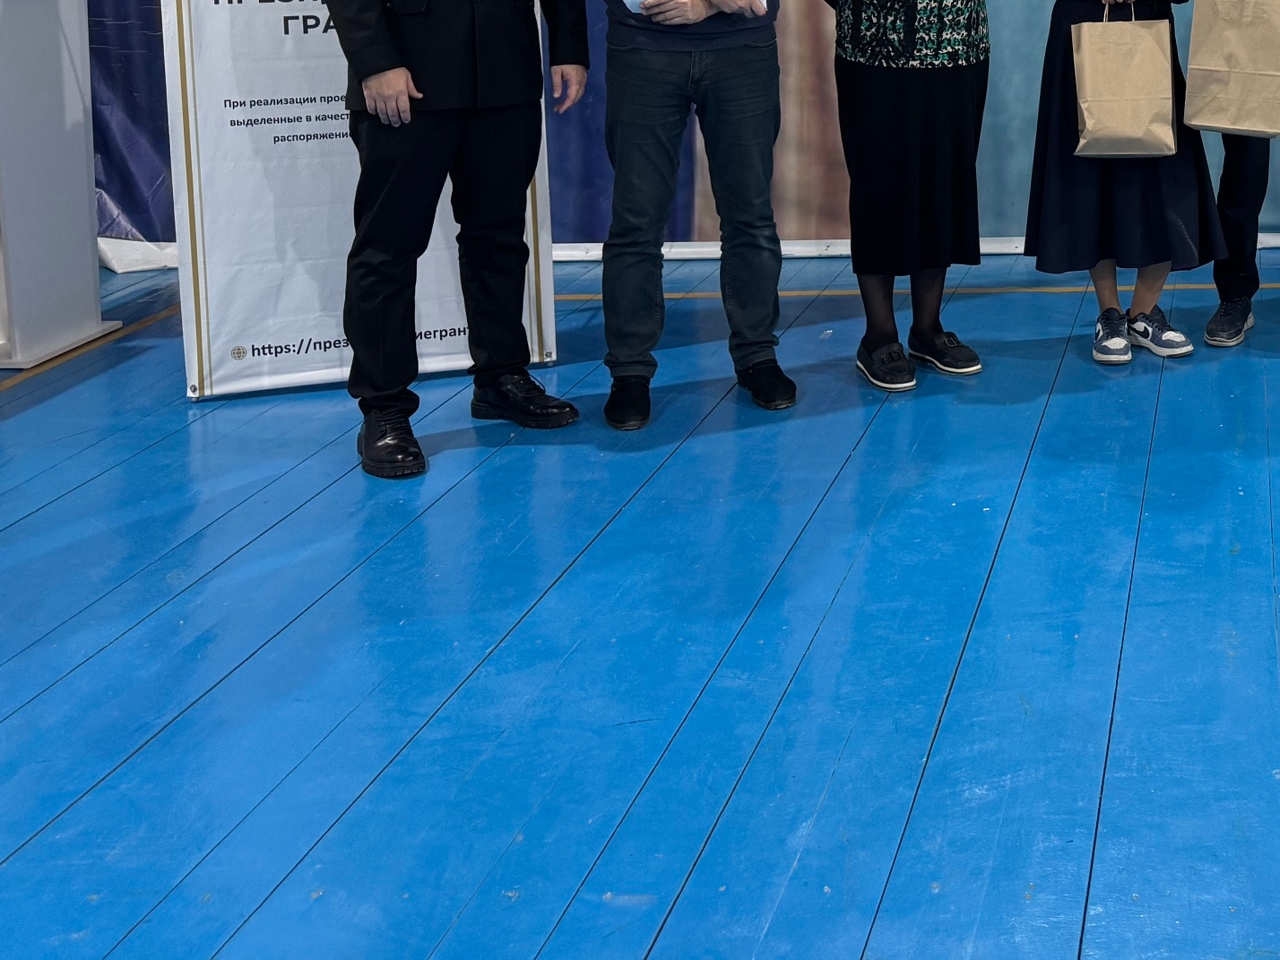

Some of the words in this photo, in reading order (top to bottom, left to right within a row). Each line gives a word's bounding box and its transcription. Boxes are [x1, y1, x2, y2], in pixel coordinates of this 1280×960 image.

[223, 99, 247, 110] При
[249, 95, 317, 109] реализации
[229, 114, 303, 127] выделенные
[273, 131, 352, 145] распоряжени
